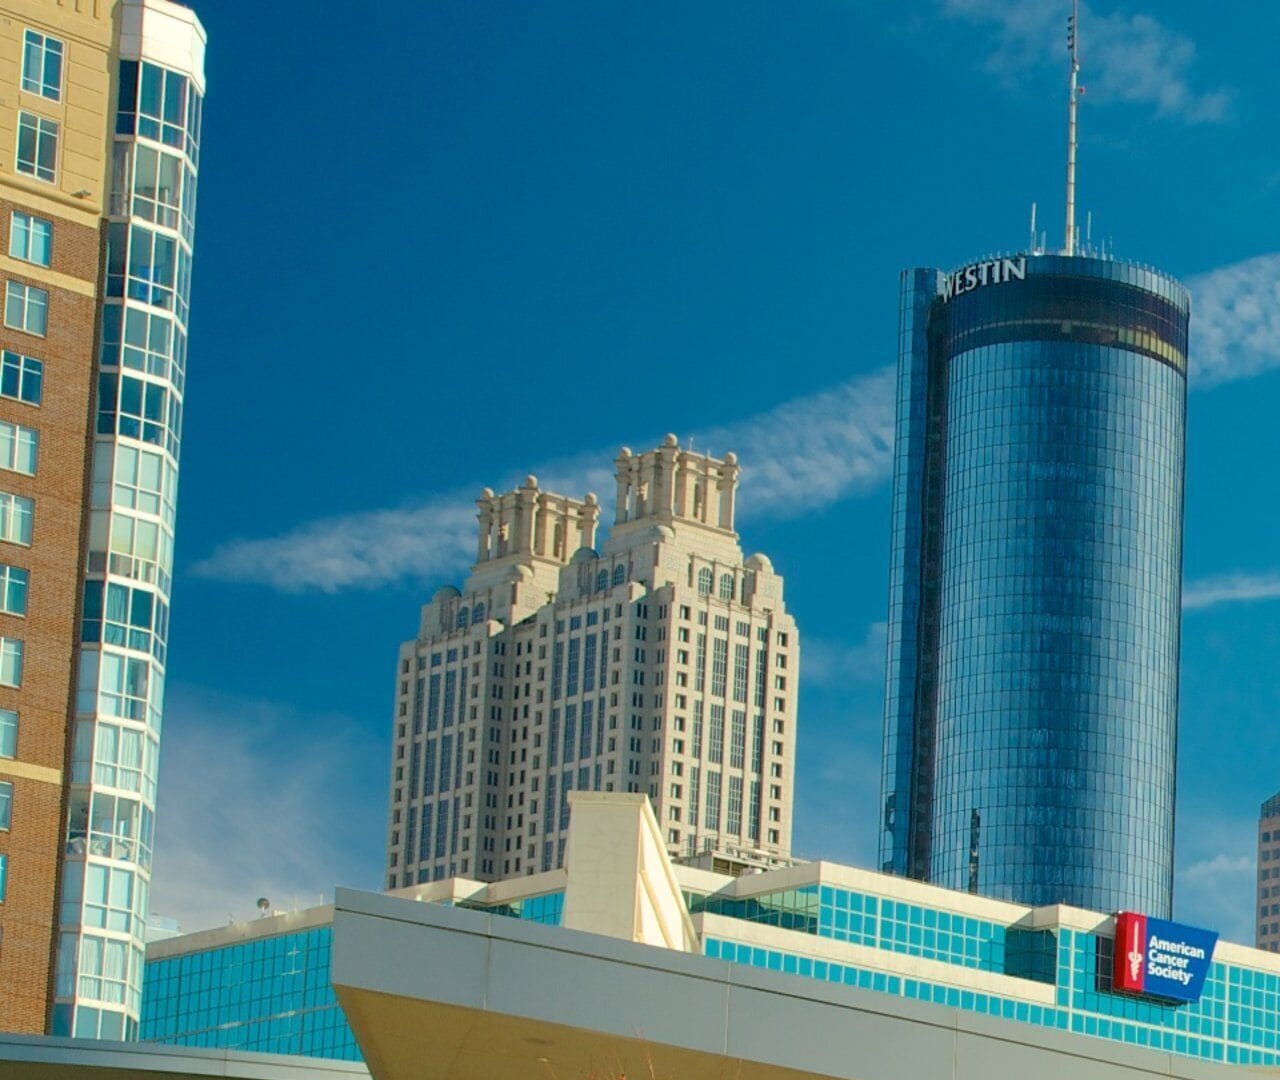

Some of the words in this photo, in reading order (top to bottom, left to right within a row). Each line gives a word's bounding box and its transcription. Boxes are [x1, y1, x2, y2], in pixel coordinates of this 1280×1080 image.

[939, 257, 1026, 303] WESTIN
[1148, 935, 1205, 960] American
[1148, 949, 1189, 969] Cancer
[1147, 962, 1190, 986] Society
